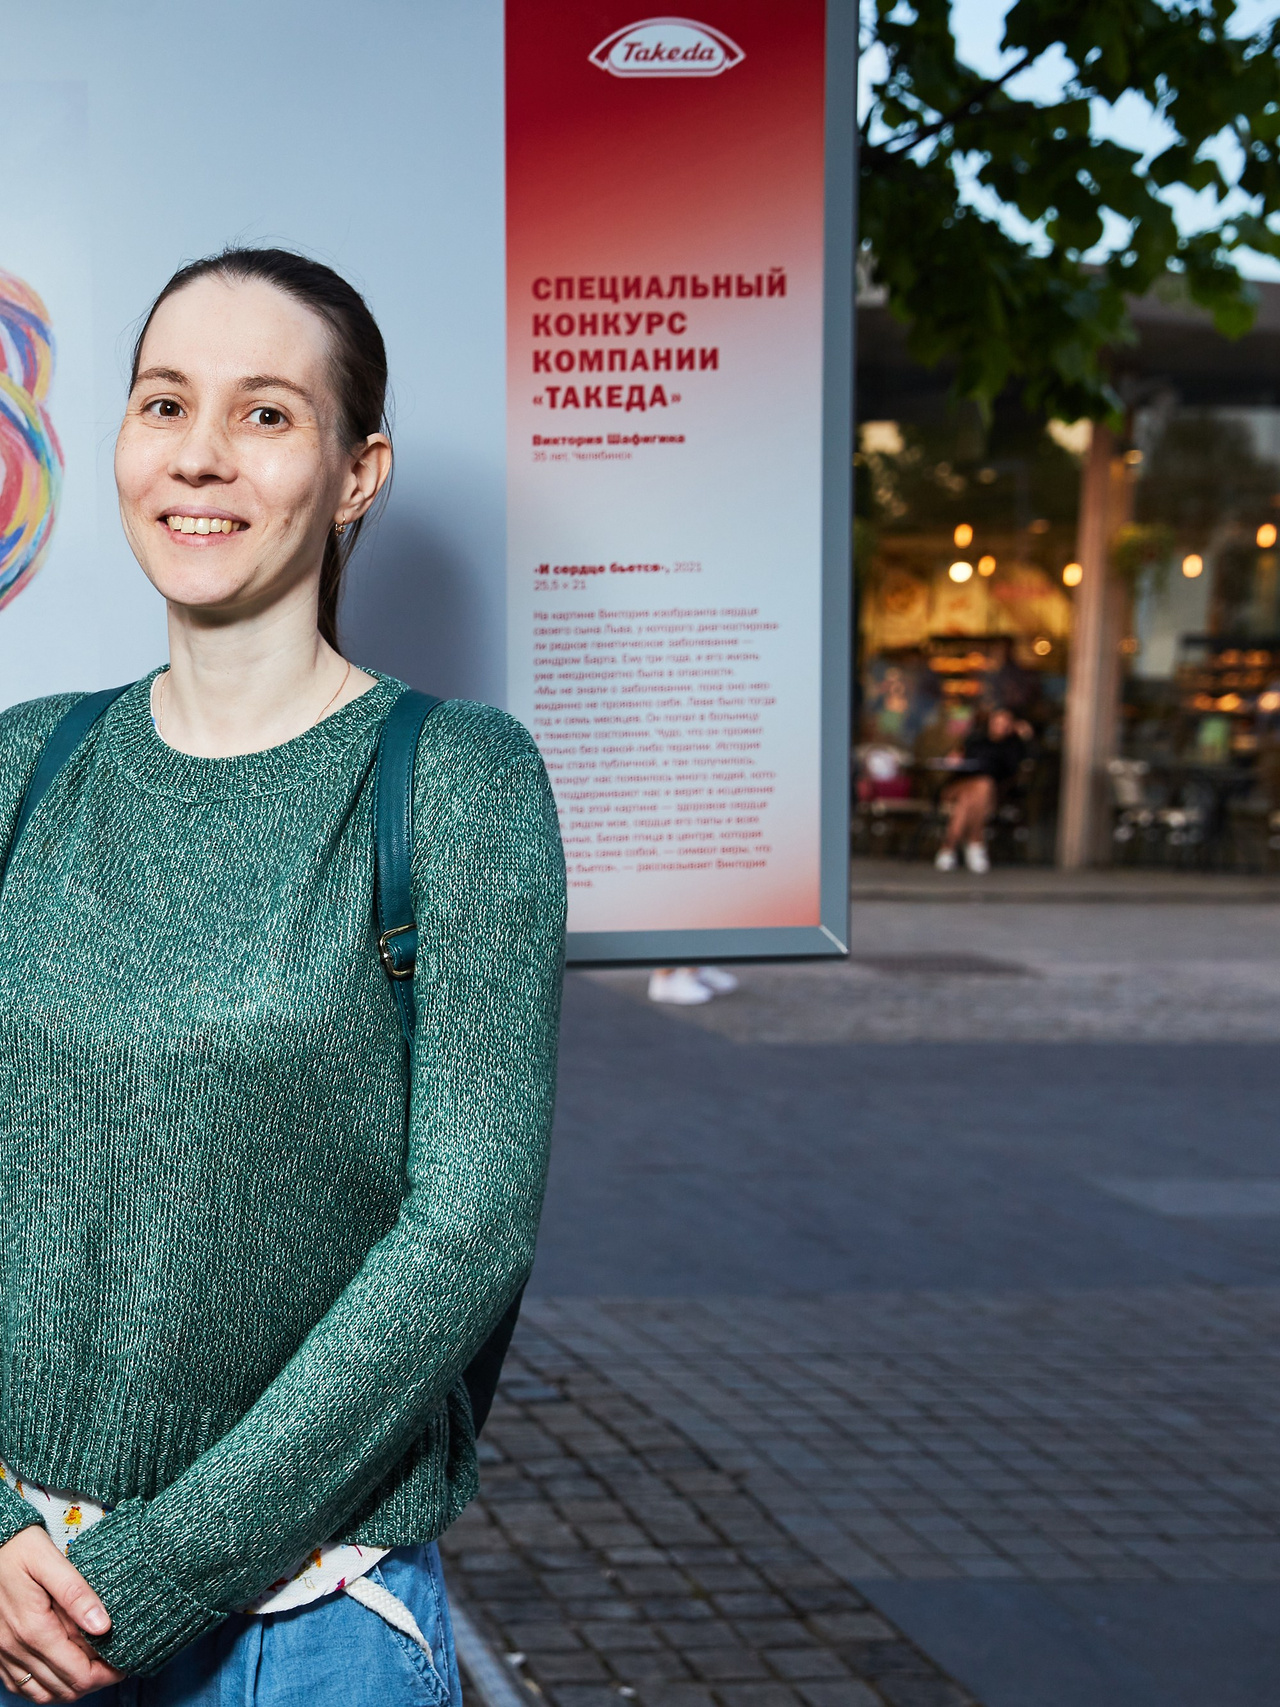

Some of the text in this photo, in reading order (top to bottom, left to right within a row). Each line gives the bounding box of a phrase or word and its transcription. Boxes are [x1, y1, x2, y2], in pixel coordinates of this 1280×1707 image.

[624, 42, 714, 62] Takeda
[532, 267, 787, 304] СПЕЦИАЛЬНЫЙ
[532, 312, 687, 337] КОНКУРС
[532, 348, 719, 373] КОМПАНИИ
[533, 384, 682, 412] «ТАКЕДА»
[532, 434, 685, 447] Виктория Шафигина
[572, 450, 632, 460] Челябинск
[553, 565, 606, 576] сердце
[673, 562, 702, 573] 2021
[550, 611, 596, 621] картине
[598, 607, 650, 620] Виктория
[652, 607, 718, 618] изобразила
[719, 608, 760, 617] сердце
[533, 627, 572, 636] своего
[573, 626, 602, 635] сына
[644, 624, 695, 634] которого
[696, 622, 780, 633] диагностирова-
[548, 642, 589, 651] редкое
[590, 640, 665, 649] генетическое
[668, 637, 740, 648] заболевание
[532, 657, 582, 667] синдром
[725, 653, 760, 661] жизнь
[556, 670, 634, 682] неоднократно
[636, 668, 665, 678] была
[576, 686, 609, 695] знали
[697, 683, 724, 692] пока
[533, 702, 583, 712] жиданно
[600, 700, 654, 710] проявило
[716, 696, 746, 707] было
[747, 697, 777, 707] тогда
[563, 716, 592, 725] семь
[663, 714, 697, 723] попал
[708, 710, 760, 722] больницу
[545, 732, 592, 740] тяжелом
[721, 727, 764, 736] прожил
[715, 740, 762, 752] История
[566, 761, 598, 770] стала
